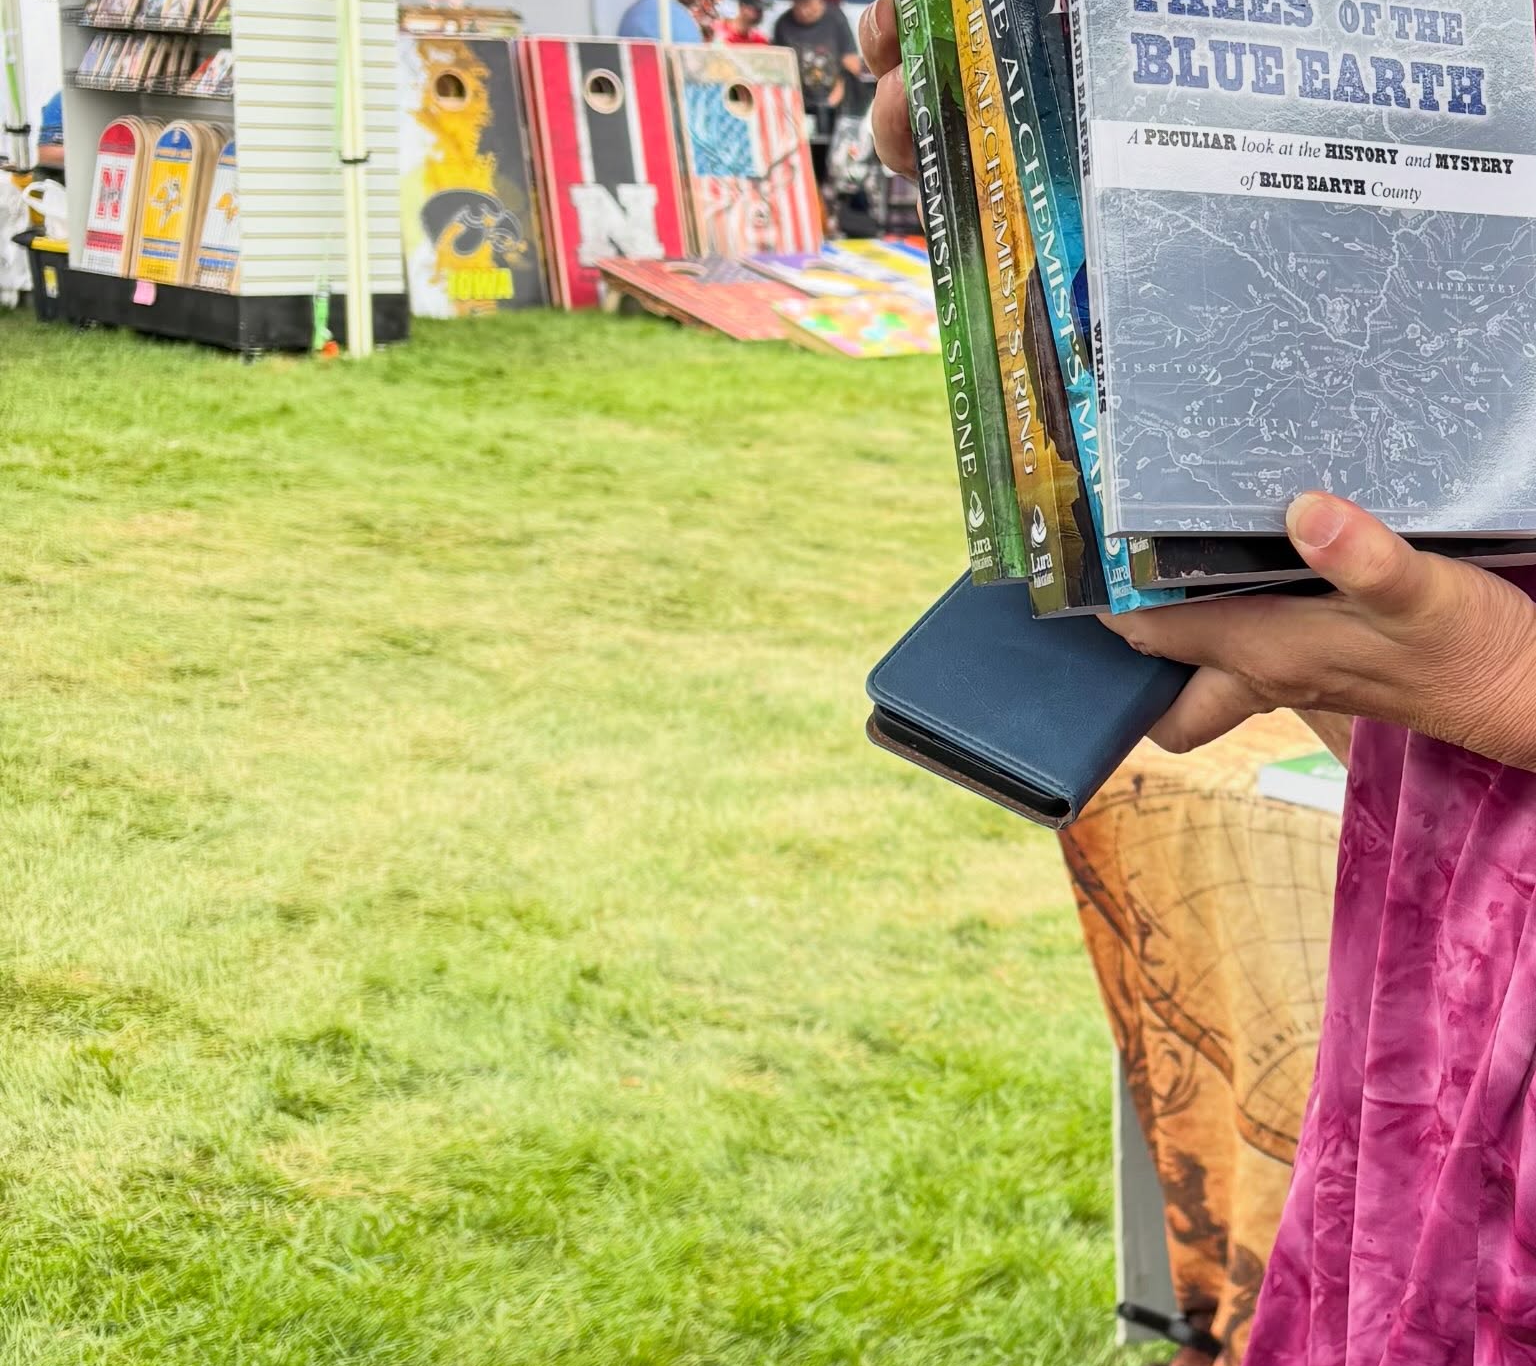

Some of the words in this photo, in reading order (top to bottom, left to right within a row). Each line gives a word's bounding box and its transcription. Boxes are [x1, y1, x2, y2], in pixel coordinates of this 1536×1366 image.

[1071, 7, 1084, 80] BLUE
[1338, 0, 1381, 35] OF
[1390, 5, 1463, 46] THE
[1131, 32, 1285, 95] BLUE
[1297, 48, 1487, 116] EARTH
[1077, 82, 1091, 179] EARTH
[1127, 130, 1139, 145] A
[1144, 128, 1237, 152] PECULIAR
[1241, 135, 1274, 154] look
[1279, 142, 1294, 156] at
[1299, 142, 1321, 159] the
[1324, 143, 1399, 166] HISTORY
[1405, 152, 1432, 169] and
[1435, 153, 1514, 175] MYSTERY
[569, 183, 665, 267] N
[1001, 56, 1086, 385] ALCHEMIST'S
[1240, 171, 1256, 190] of
[1259, 172, 1304, 191] BLUE
[1307, 175, 1366, 196] EARTH
[1371, 181, 1422, 203] County
[907, 54, 958, 327] ALCHEMIST'S
[946, 341, 977, 479] STONE
[1093, 319, 1108, 415] WILLIS
[1011, 367, 1038, 475] RING
[968, 537, 992, 556] Lura
[1031, 552, 1053, 574] Lura
